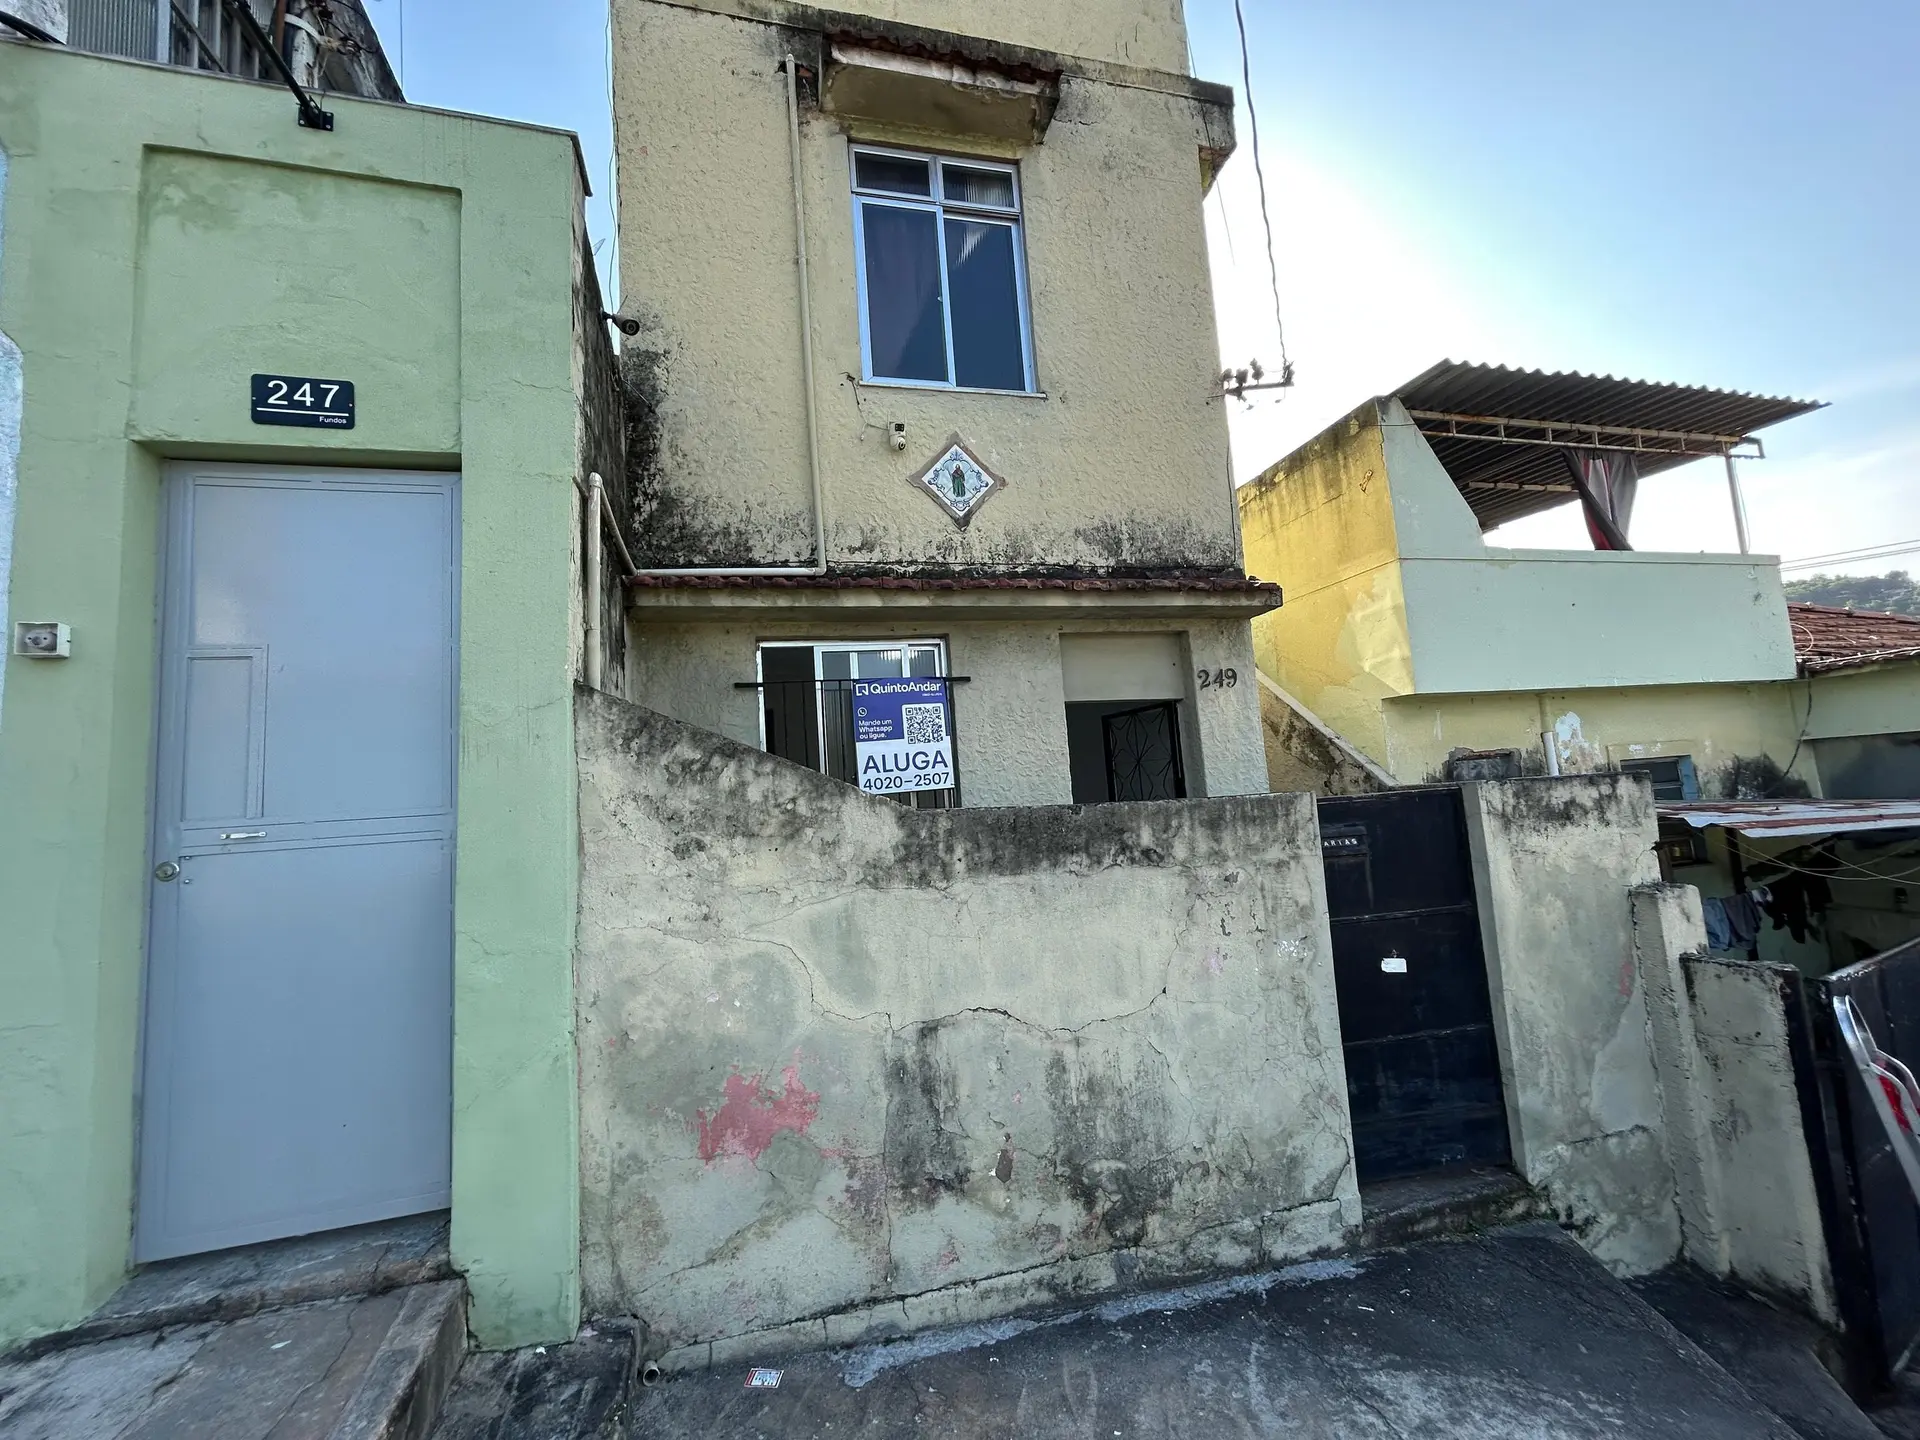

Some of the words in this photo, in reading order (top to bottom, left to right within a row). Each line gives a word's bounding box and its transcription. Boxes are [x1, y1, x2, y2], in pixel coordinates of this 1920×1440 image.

[267, 380, 340, 408] 247
[319, 416, 347, 424] Fundos
[870, 682, 941, 694] QuintoAndar
[1197, 668, 1237, 690] 249
[863, 750, 949, 775] ALUGA
[863, 772, 950, 791] 4020-2507
